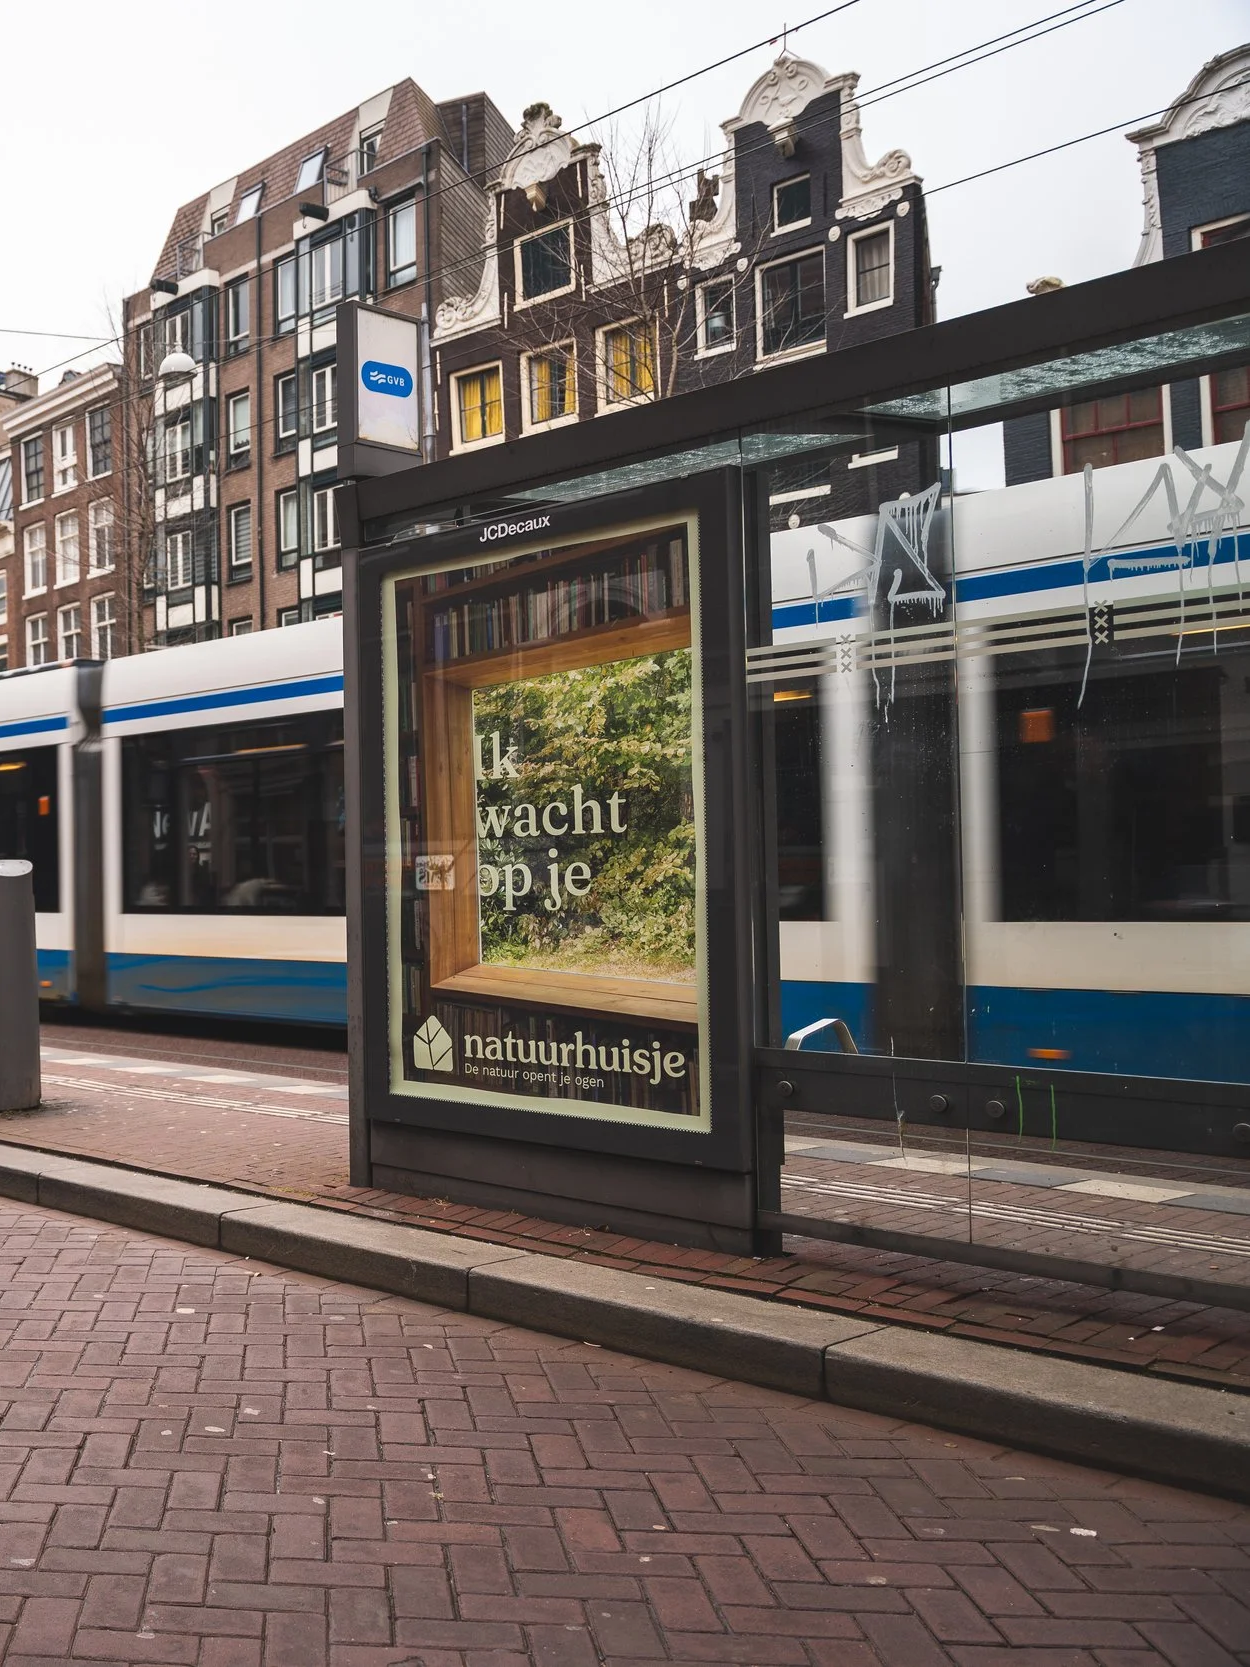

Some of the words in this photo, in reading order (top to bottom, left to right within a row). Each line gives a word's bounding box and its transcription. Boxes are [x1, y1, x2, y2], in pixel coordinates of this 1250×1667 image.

[387, 375, 405, 387] GVB
[479, 514, 551, 543] JCDecaux
[473, 730, 519, 780] Ik
[476, 783, 628, 838] wacht
[478, 860, 533, 911] op
[544, 848, 592, 911] je
[463, 1030, 686, 1085] natuurhuisje
[464, 1062, 479, 1075] De
[482, 1065, 520, 1079] natuur
[522, 1068, 557, 1083] opent
[559, 1071, 571, 1087] je
[575, 1074, 604, 1090] ogen
